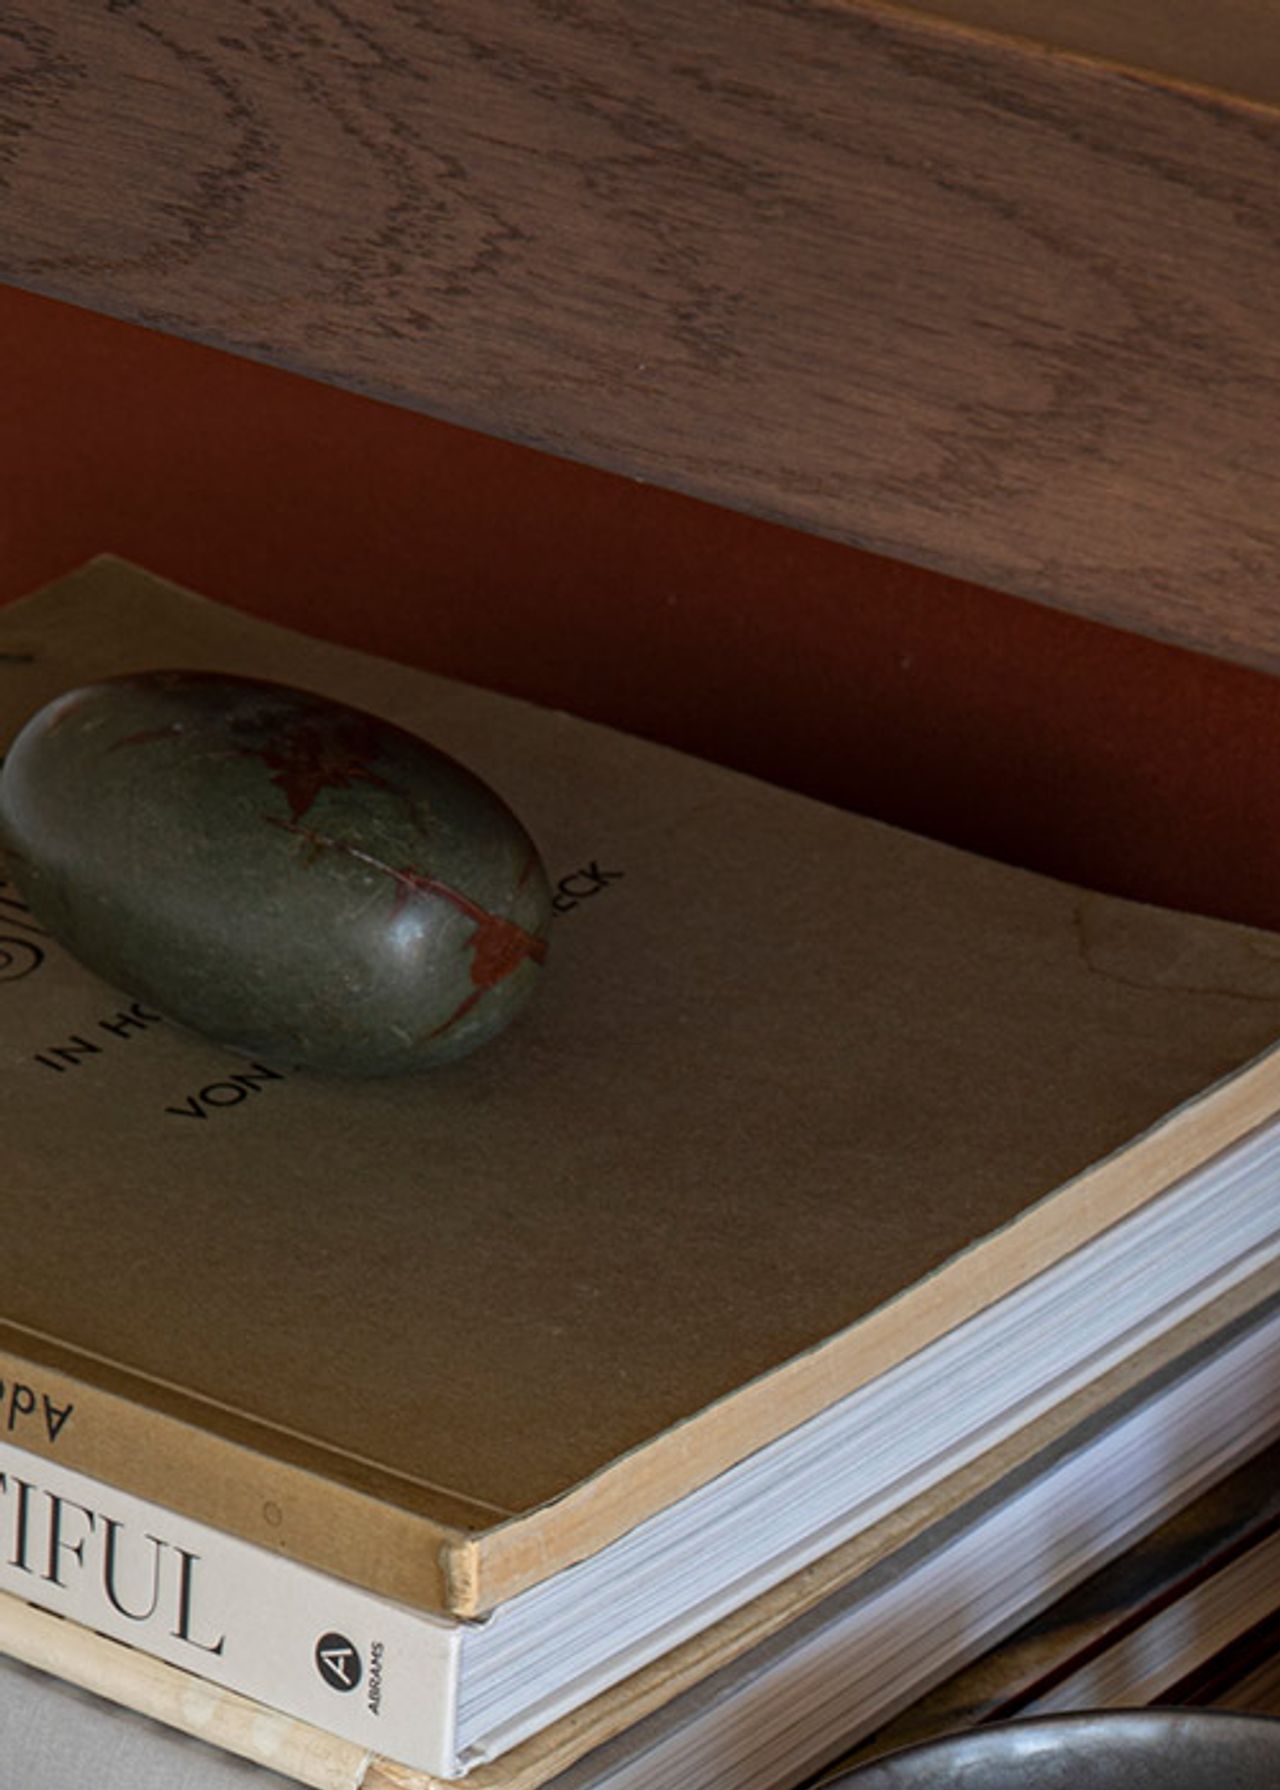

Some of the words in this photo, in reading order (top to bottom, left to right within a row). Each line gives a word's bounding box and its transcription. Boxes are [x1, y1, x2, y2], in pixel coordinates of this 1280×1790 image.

[34, 1035, 103, 1072] IN
[164, 1061, 284, 1120] VON
[0, 1380, 74, 1443] Ad
[0, 1471, 226, 1656] IFUL
[367, 1640, 385, 1716] ABRAMS
